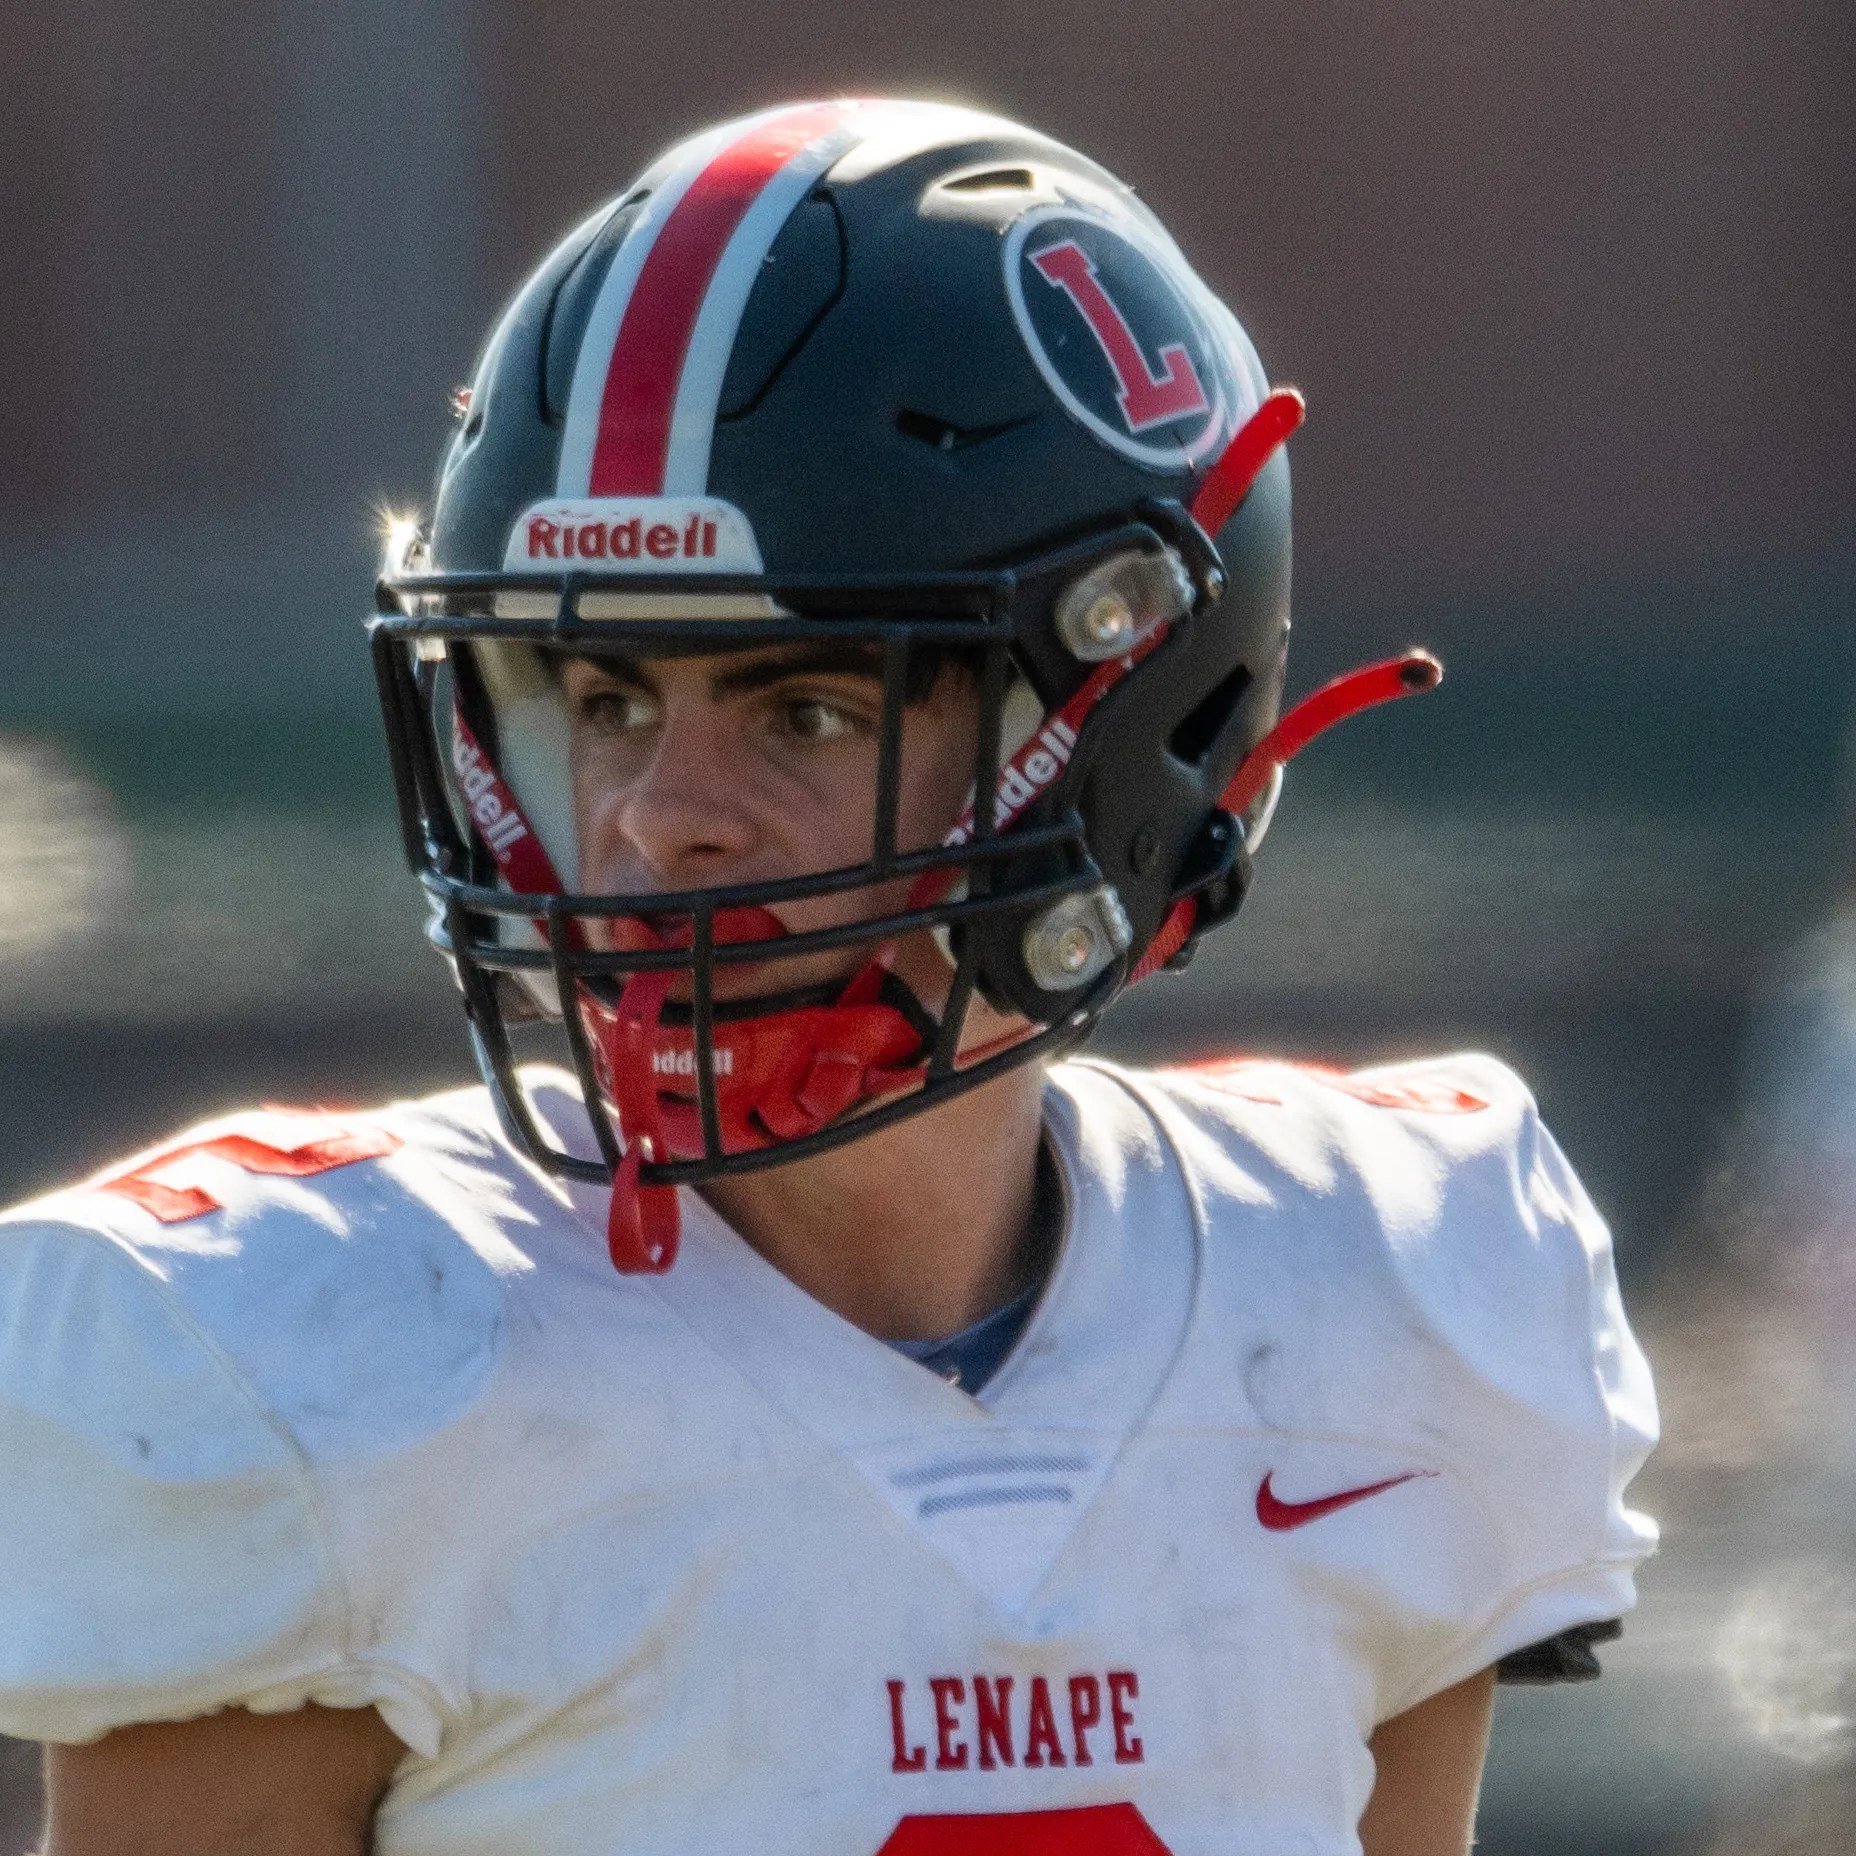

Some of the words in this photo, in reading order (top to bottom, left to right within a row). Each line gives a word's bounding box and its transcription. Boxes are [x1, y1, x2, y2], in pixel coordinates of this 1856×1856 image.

[1028, 239, 1209, 434] L
[527, 514, 717, 558] Riddell
[886, 1671, 1143, 1774] LENAPE
